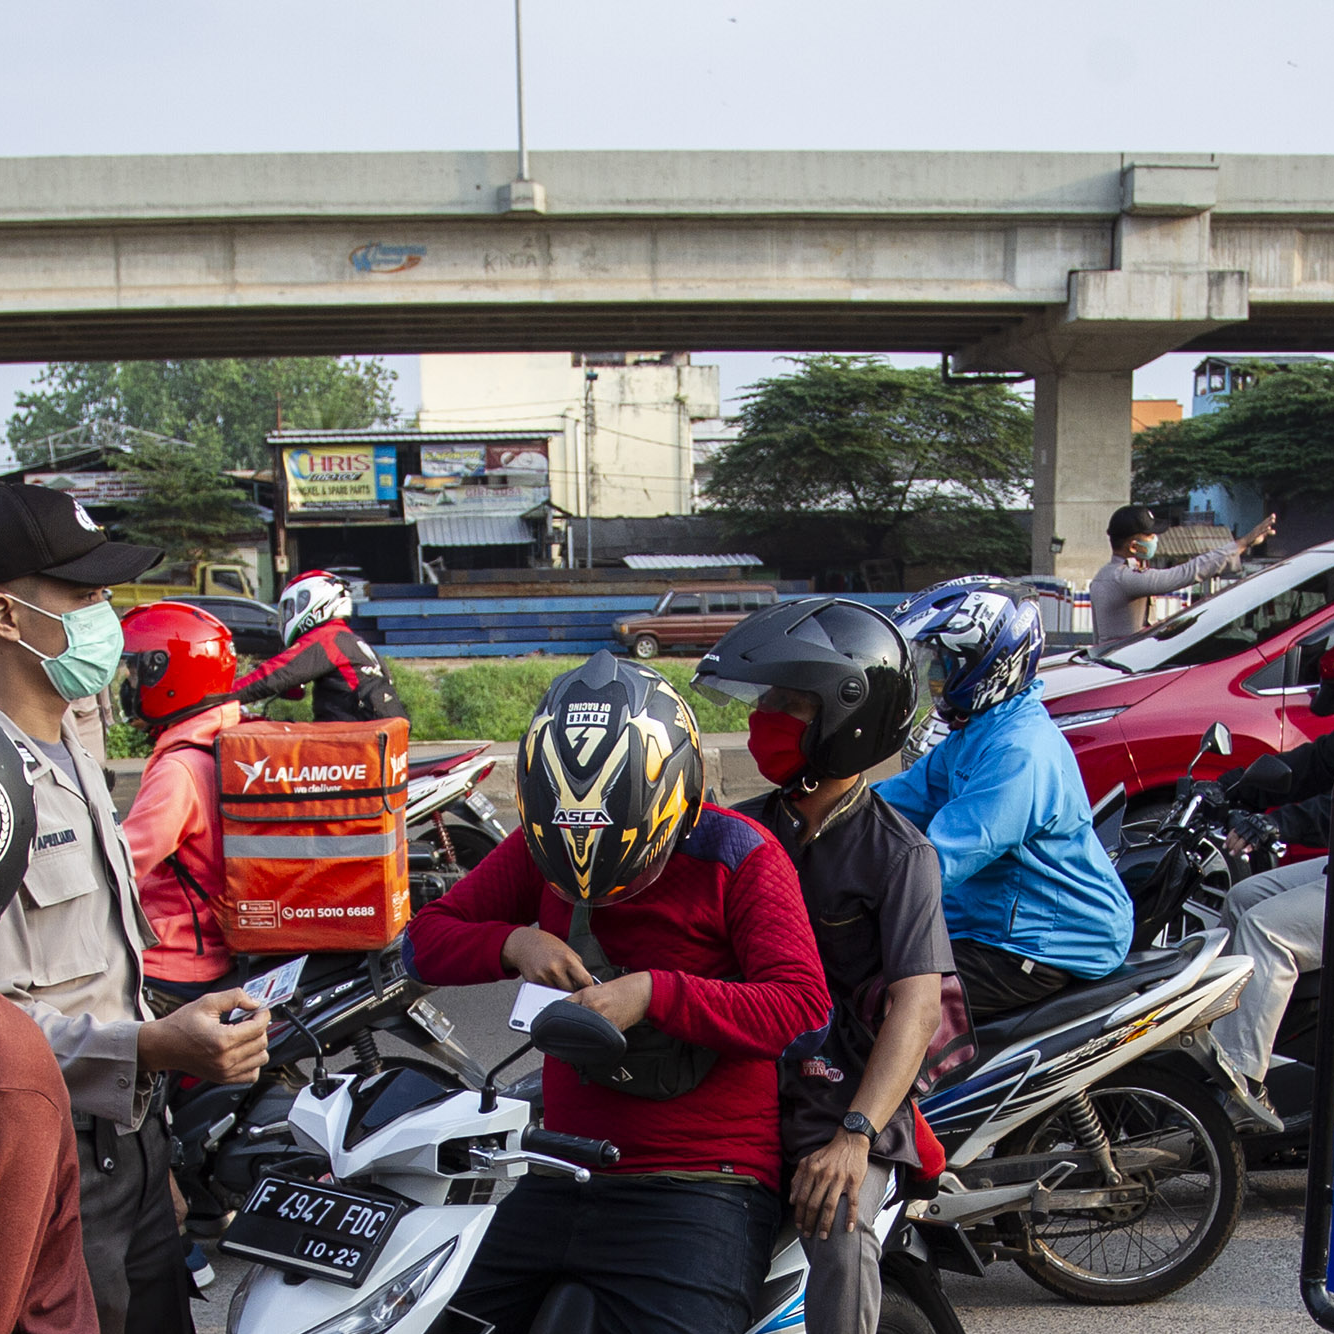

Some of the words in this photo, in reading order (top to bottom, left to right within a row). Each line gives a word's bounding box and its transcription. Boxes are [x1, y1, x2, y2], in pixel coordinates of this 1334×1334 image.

[288, 449, 371, 480] CHRIS
[568, 702, 598, 713] RACING
[600, 703, 612, 712] OF
[569, 715, 606, 723] POWER
[264, 764, 367, 783] LALAMOVE
[293, 785, 307, 794] we
[308, 784, 342, 793] deliver
[553, 809, 614, 824] ASCA
[295, 908, 315, 918] 021
[317, 907, 344, 917] 5010
[346, 906, 375, 917] 6688
[252, 1185, 277, 1212] F
[276, 1191, 336, 1226] 4947
[336, 1204, 387, 1239] FDC
